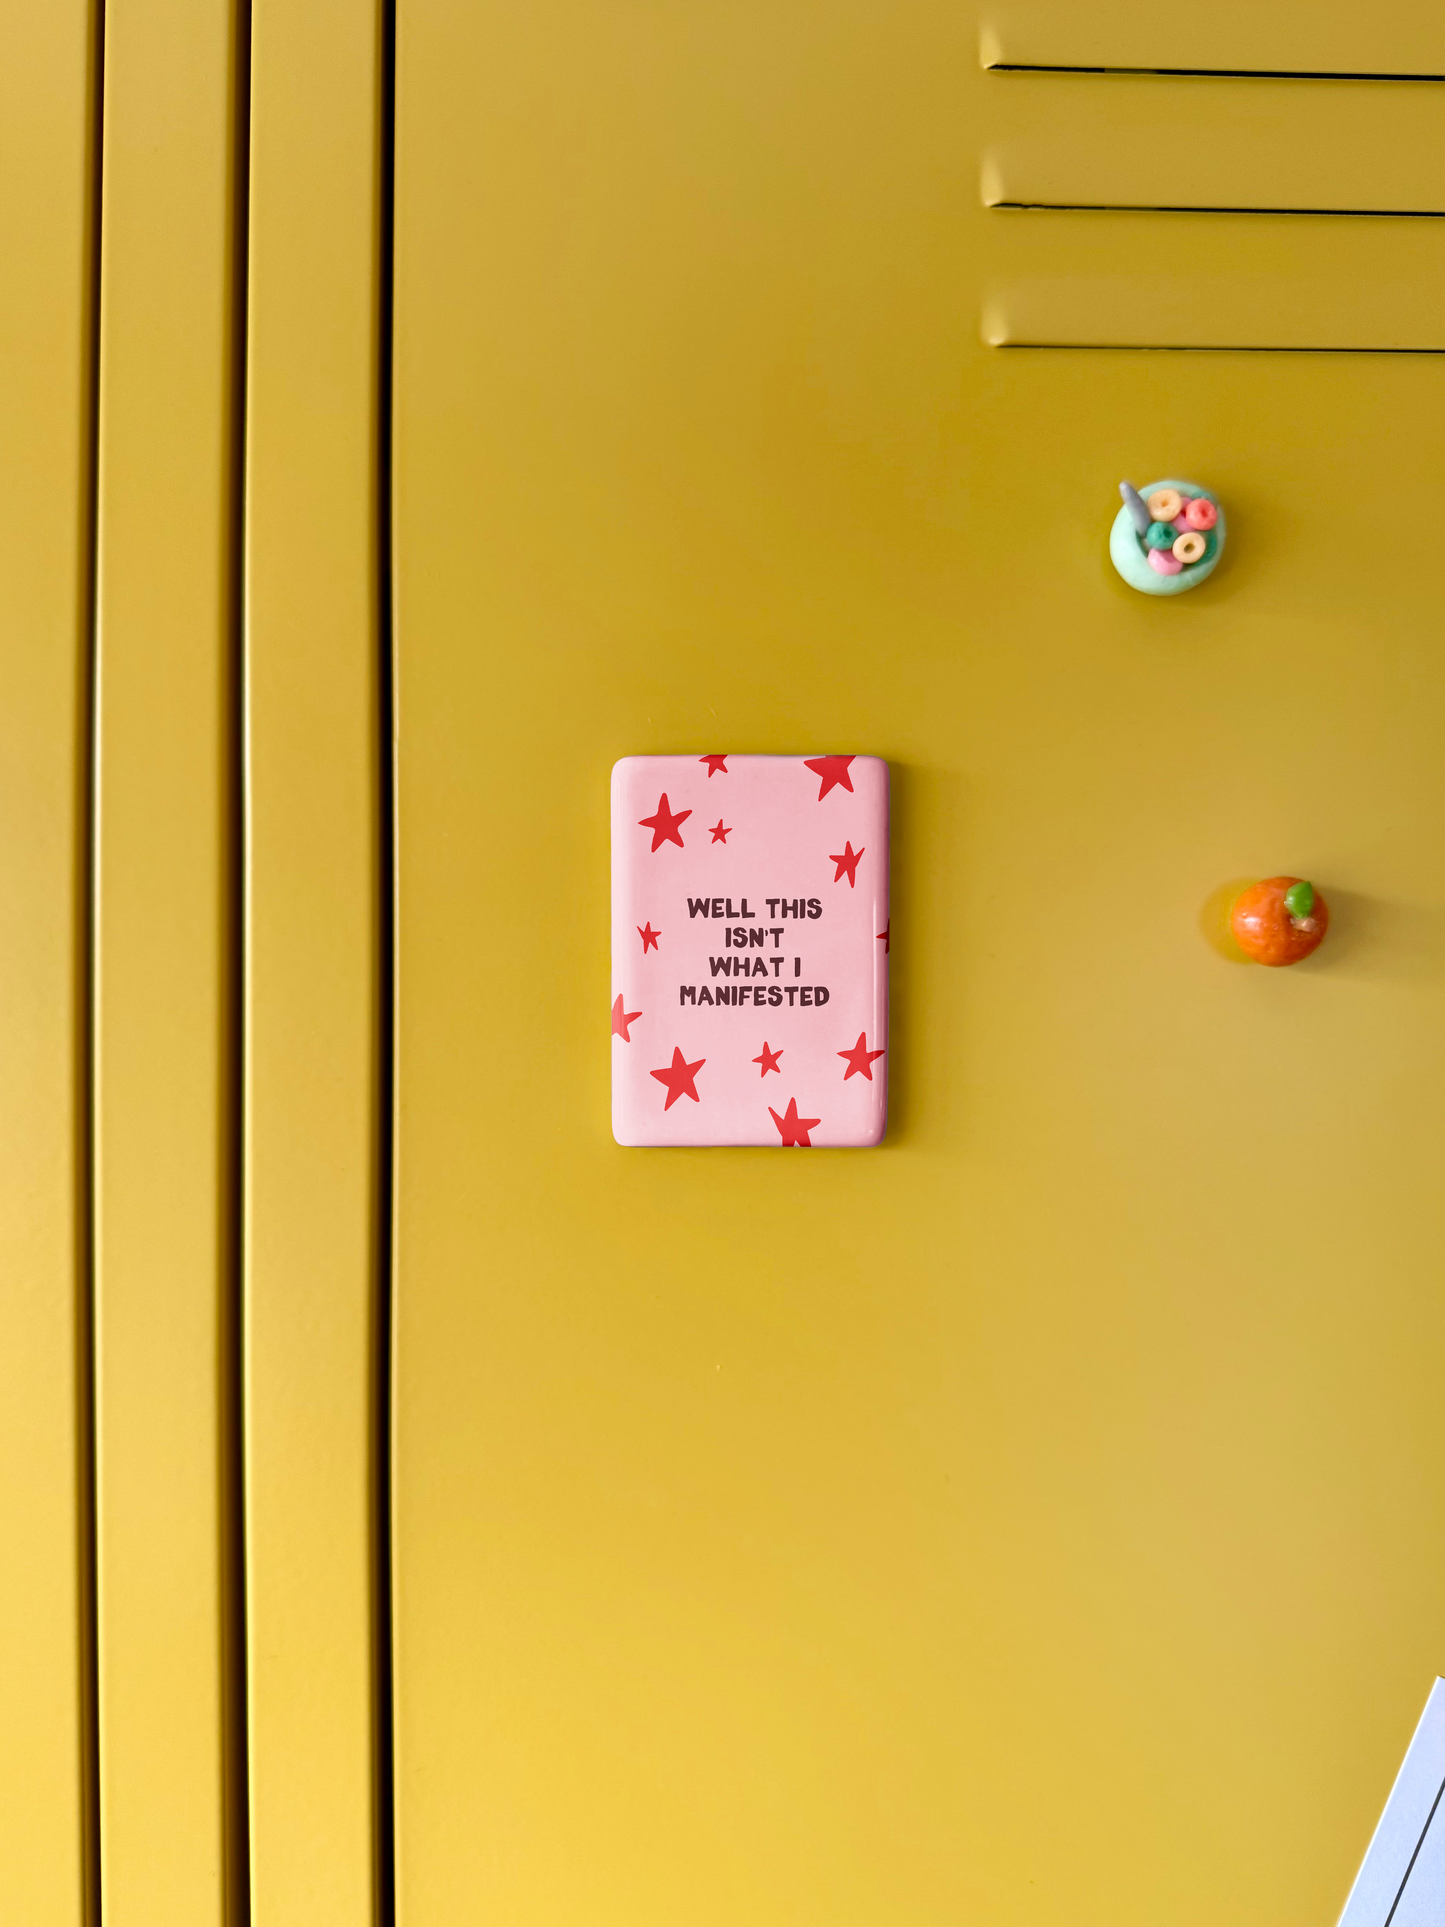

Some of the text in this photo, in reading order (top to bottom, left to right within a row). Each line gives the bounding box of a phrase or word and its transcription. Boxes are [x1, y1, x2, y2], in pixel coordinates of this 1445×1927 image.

[687, 898, 822, 919] WELL THIS
[725, 927, 784, 948] ISN'T
[709, 957, 801, 977] WHAT I
[680, 986, 830, 1006] MANIFESTED
